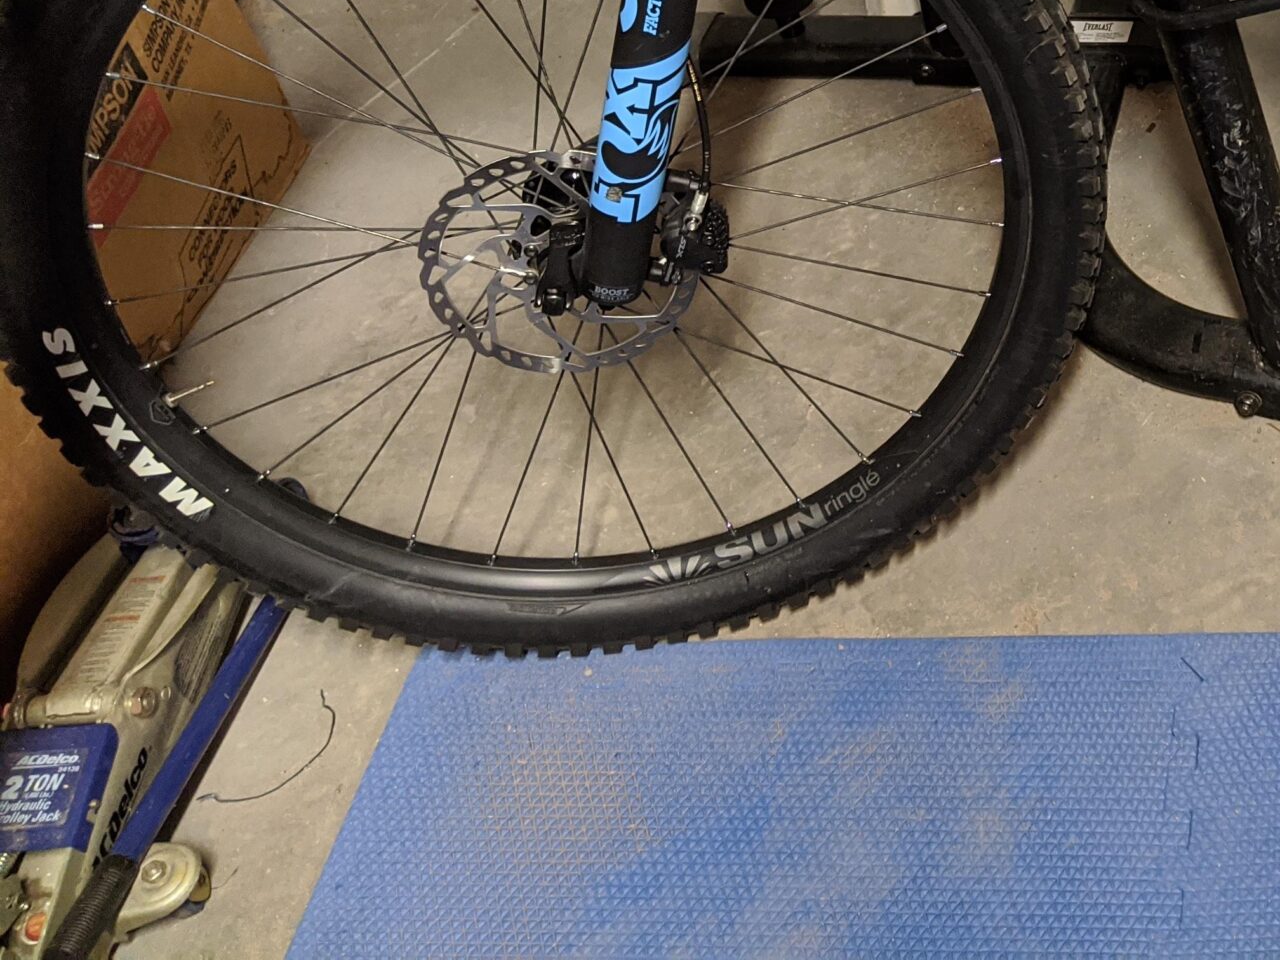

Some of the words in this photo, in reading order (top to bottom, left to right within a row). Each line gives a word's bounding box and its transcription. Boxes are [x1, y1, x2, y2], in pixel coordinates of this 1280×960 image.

[1083, 22, 1115, 32] EVERLAST
[594, 286, 630, 297] BOOST
[42, 327, 214, 517] MAXXIS
[714, 502, 828, 569] SUN
[823, 469, 881, 517] ringlé
[17, 754, 80, 766] ACDelco
[1, 776, 24, 799] 2
[25, 774, 66, 791] TON
[32, 809, 59, 822] Jack
